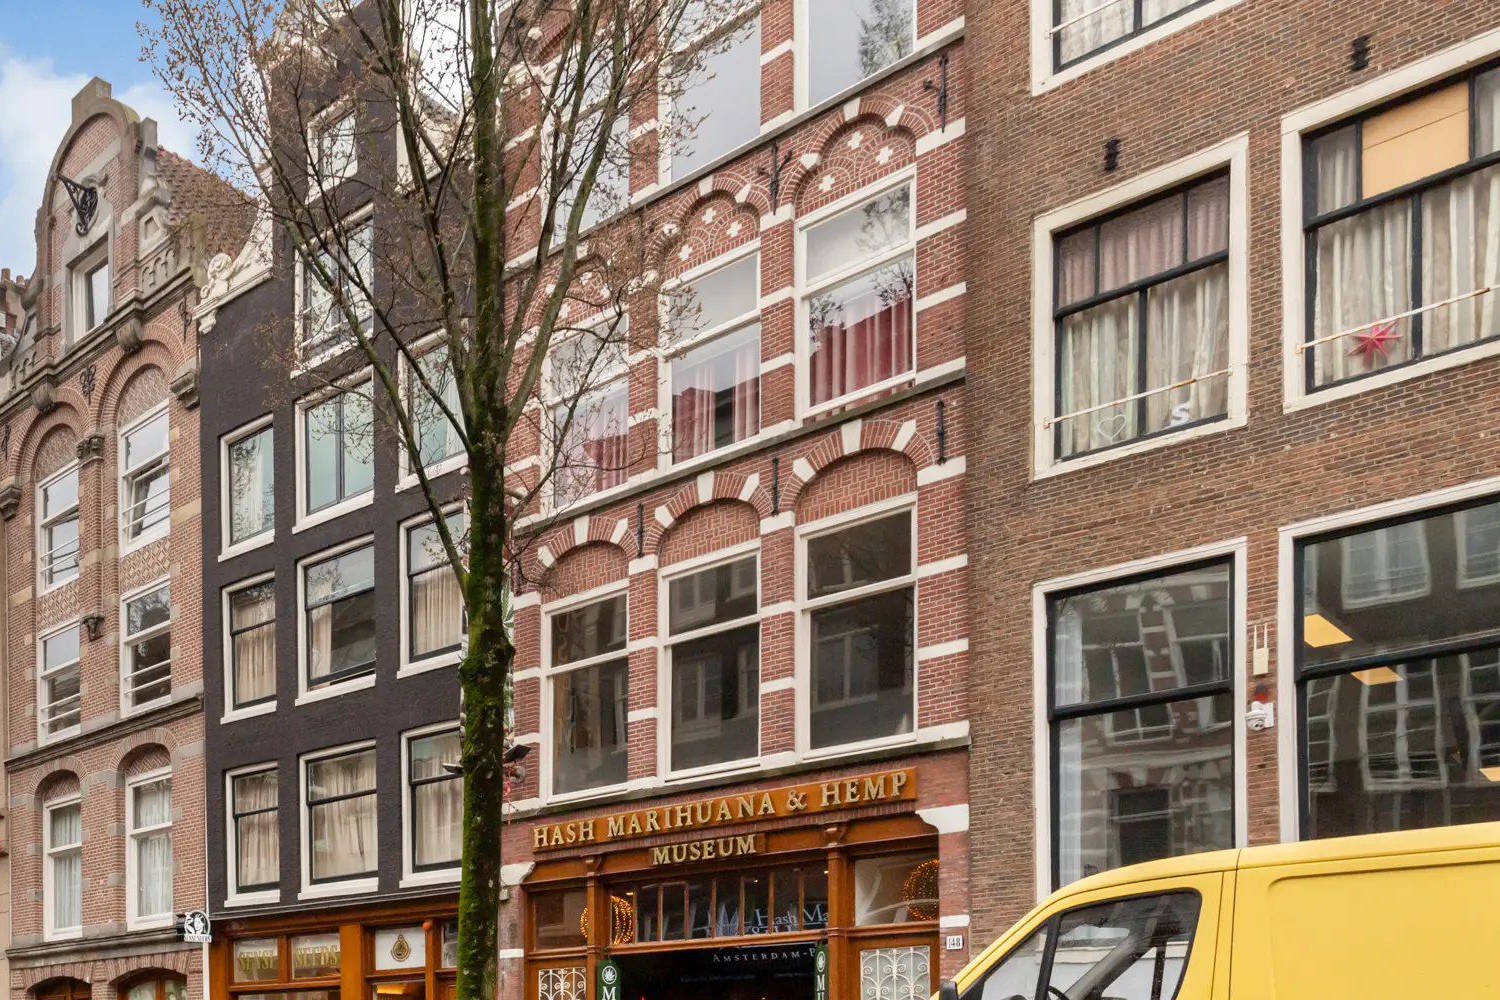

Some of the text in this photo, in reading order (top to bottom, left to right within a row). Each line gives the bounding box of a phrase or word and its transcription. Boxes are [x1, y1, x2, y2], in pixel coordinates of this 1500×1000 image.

[533, 771, 908, 848] HASH MARIHUANA & HEMP
[652, 834, 757, 865] MUSEUM
[948, 937, 961, 948] 148
[239, 945, 338, 971] SENSI SEEDS
